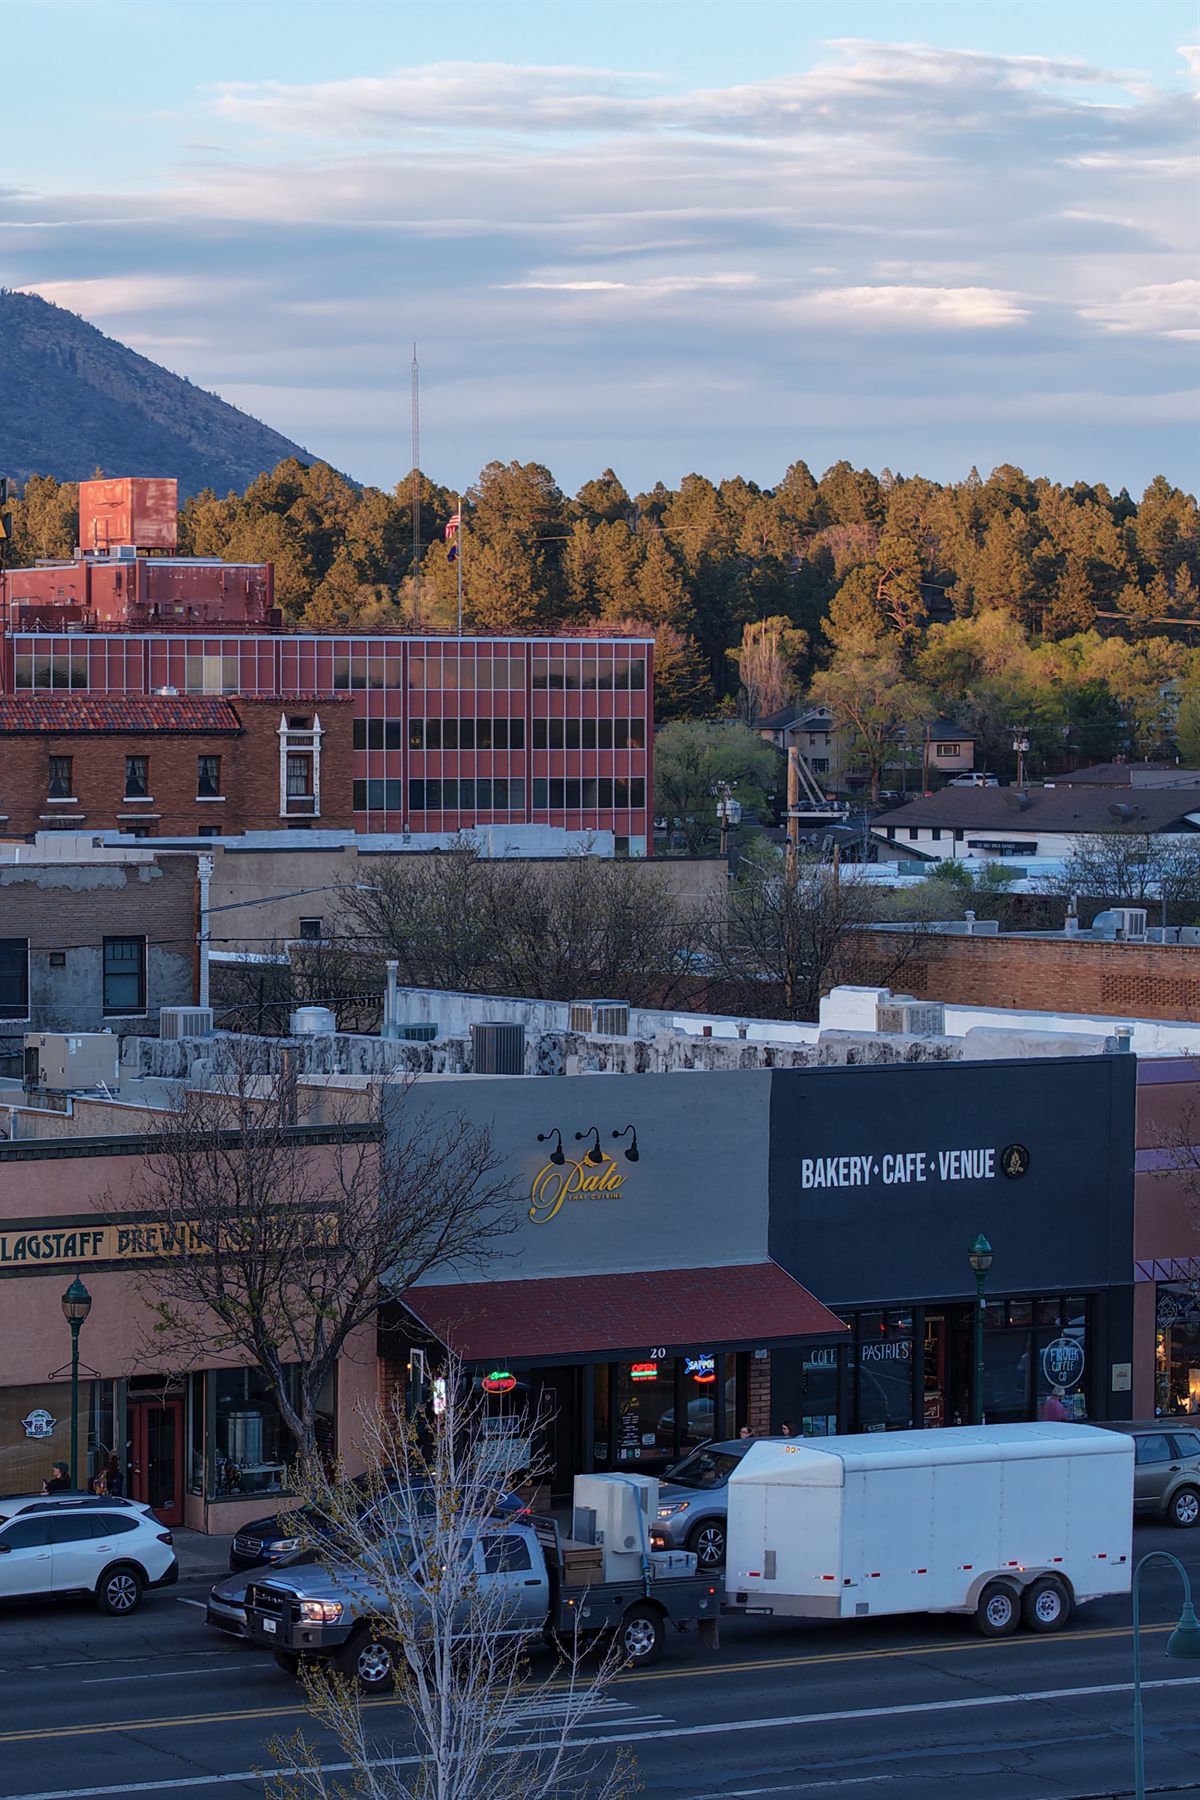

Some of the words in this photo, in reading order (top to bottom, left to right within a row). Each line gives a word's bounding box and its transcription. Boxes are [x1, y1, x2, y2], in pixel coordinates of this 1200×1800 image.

[801, 1155, 874, 1189] BAKERY
[882, 1152, 927, 1185] CAFE
[938, 1148, 996, 1180] VENUE
[529, 1159, 627, 1225] Pato
[649, 1347, 667, 1359] 20
[862, 1341, 910, 1361] PASTRIES
[631, 1363, 657, 1372] OPEN
[687, 1359, 715, 1371] SAPPO
[34, 1423, 44, 1432] 66
